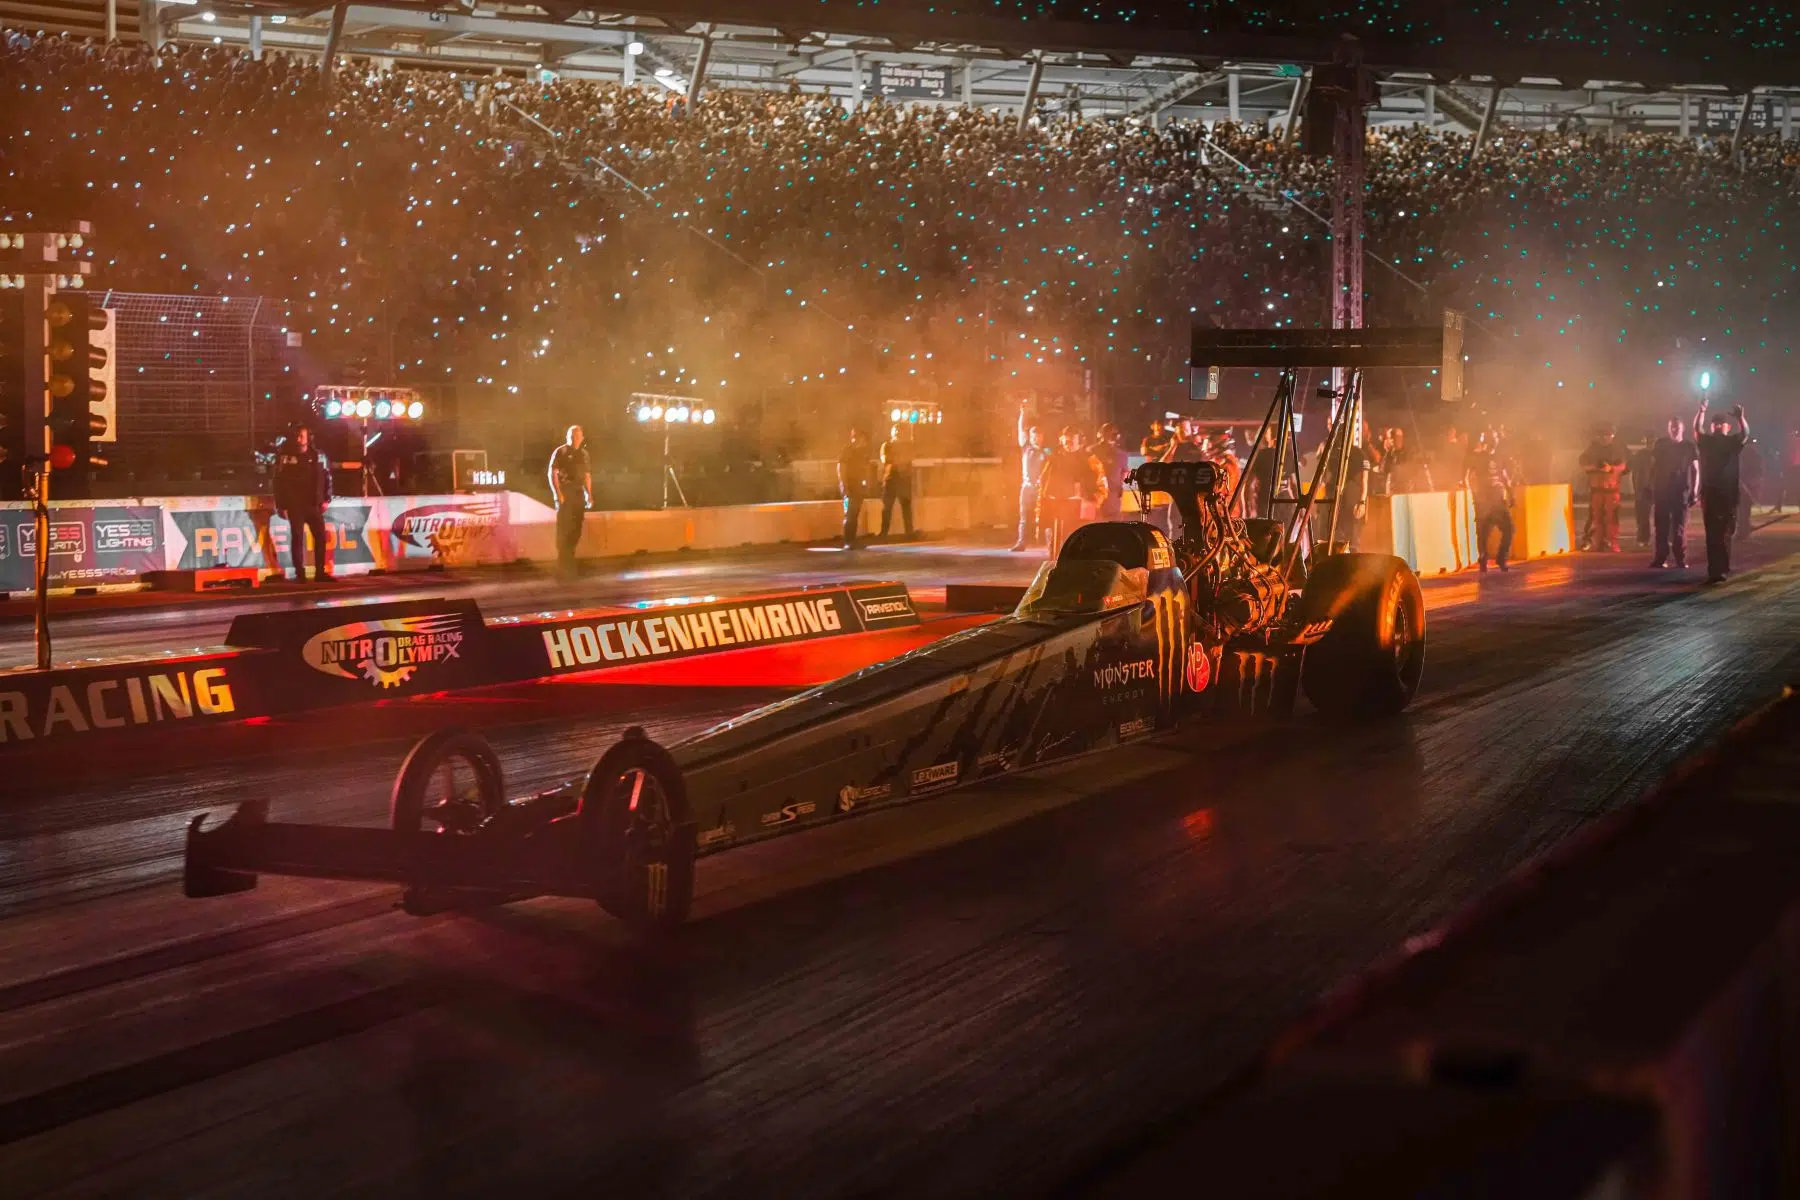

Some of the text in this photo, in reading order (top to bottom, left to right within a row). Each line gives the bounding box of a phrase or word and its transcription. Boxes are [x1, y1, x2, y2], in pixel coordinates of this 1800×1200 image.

[21, 526, 81, 541] YSSS
[96, 523, 152, 538] YESSS
[23, 540, 81, 552] SEURITY
[97, 536, 153, 549] LIGHTING
[867, 601, 907, 615] RAVENOL
[398, 631, 463, 648] DRAG RACING
[542, 598, 842, 668] HOCKENHEIMRING
[1093, 658, 1155, 690] MONSTER
[0, 667, 235, 743] RACING
